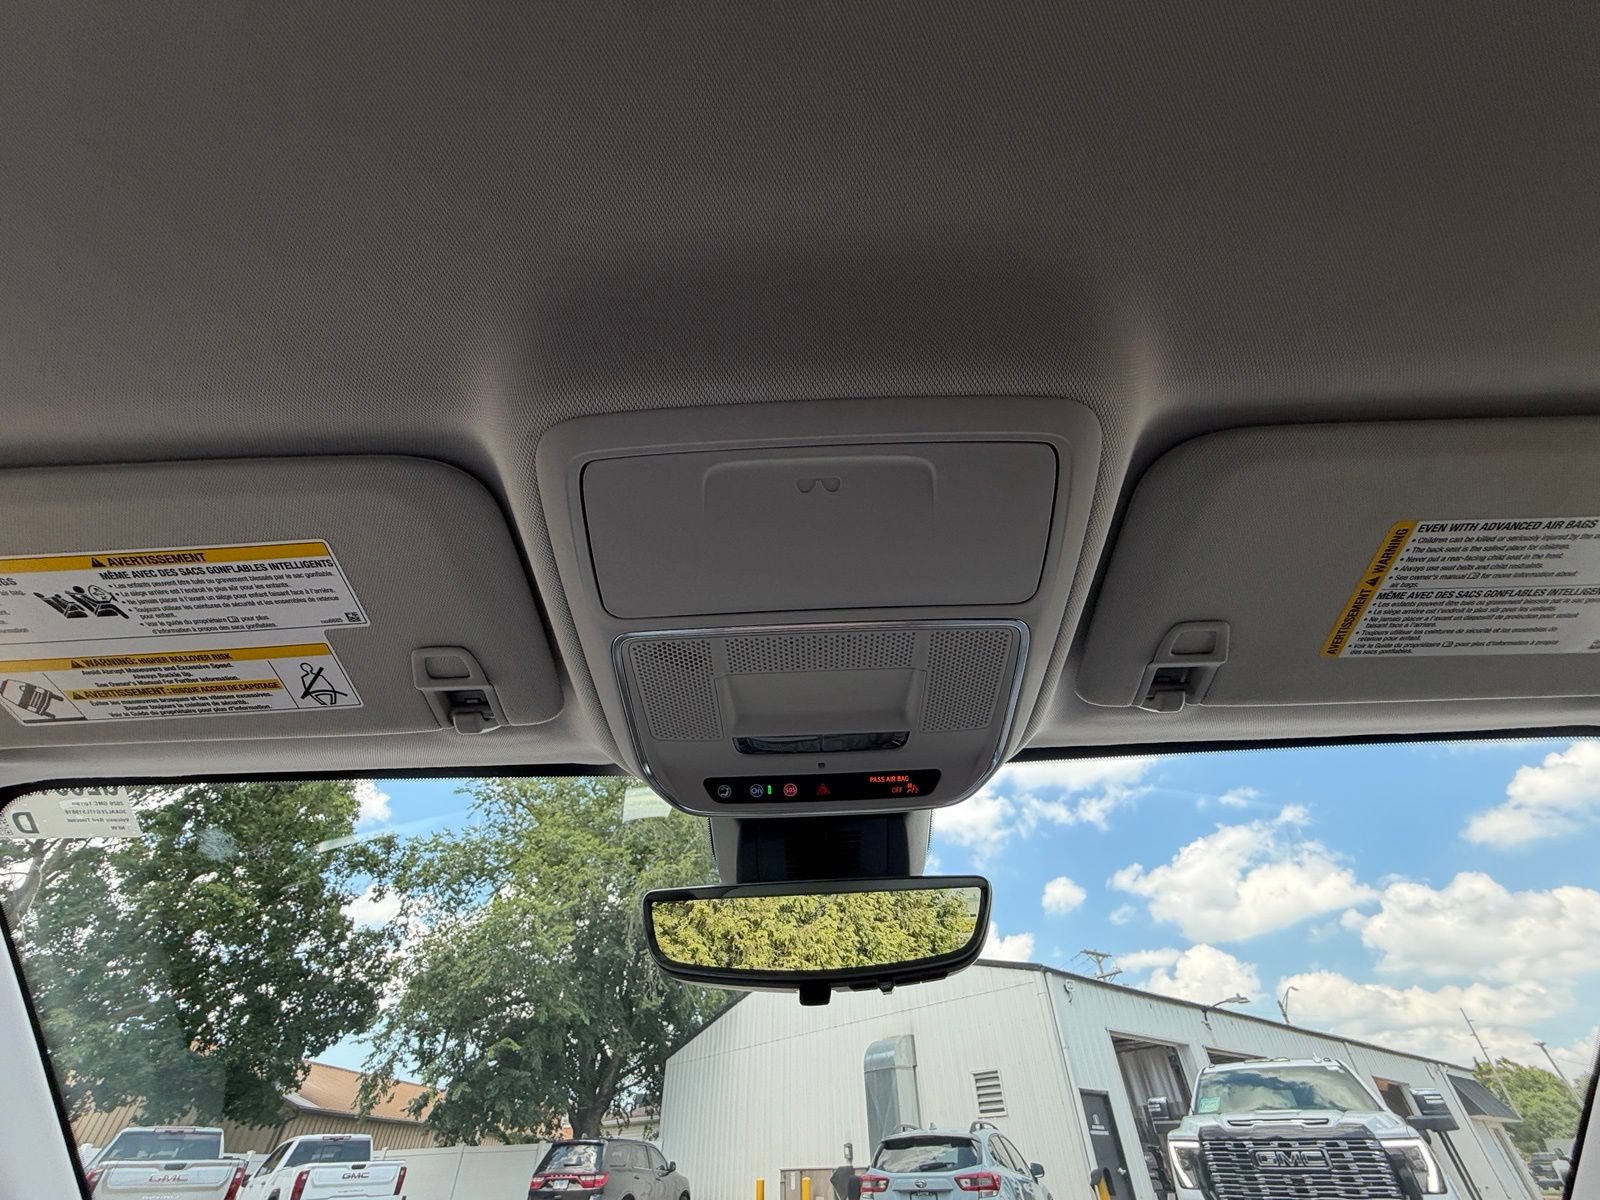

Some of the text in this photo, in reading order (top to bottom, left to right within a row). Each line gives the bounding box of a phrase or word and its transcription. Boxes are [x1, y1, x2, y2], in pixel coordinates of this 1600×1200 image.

[1417, 520, 1599, 533] EVEN WITH ADVANCED AIR BAGS
[1417, 536, 1448, 544] Children
[1371, 527, 1409, 574] WARNING
[107, 552, 206, 568] AVERTISSEMENT
[99, 559, 334, 581] MÊME AVEC DES SACS GONFLABLES INTELLIGENTS
[1376, 591, 1407, 600] MÊME
[1484, 589, 1547, 598] GONFLABLES
[1327, 588, 1372, 655] AVERTISSEMENT
[1256, 1151, 1327, 1166] GMC
